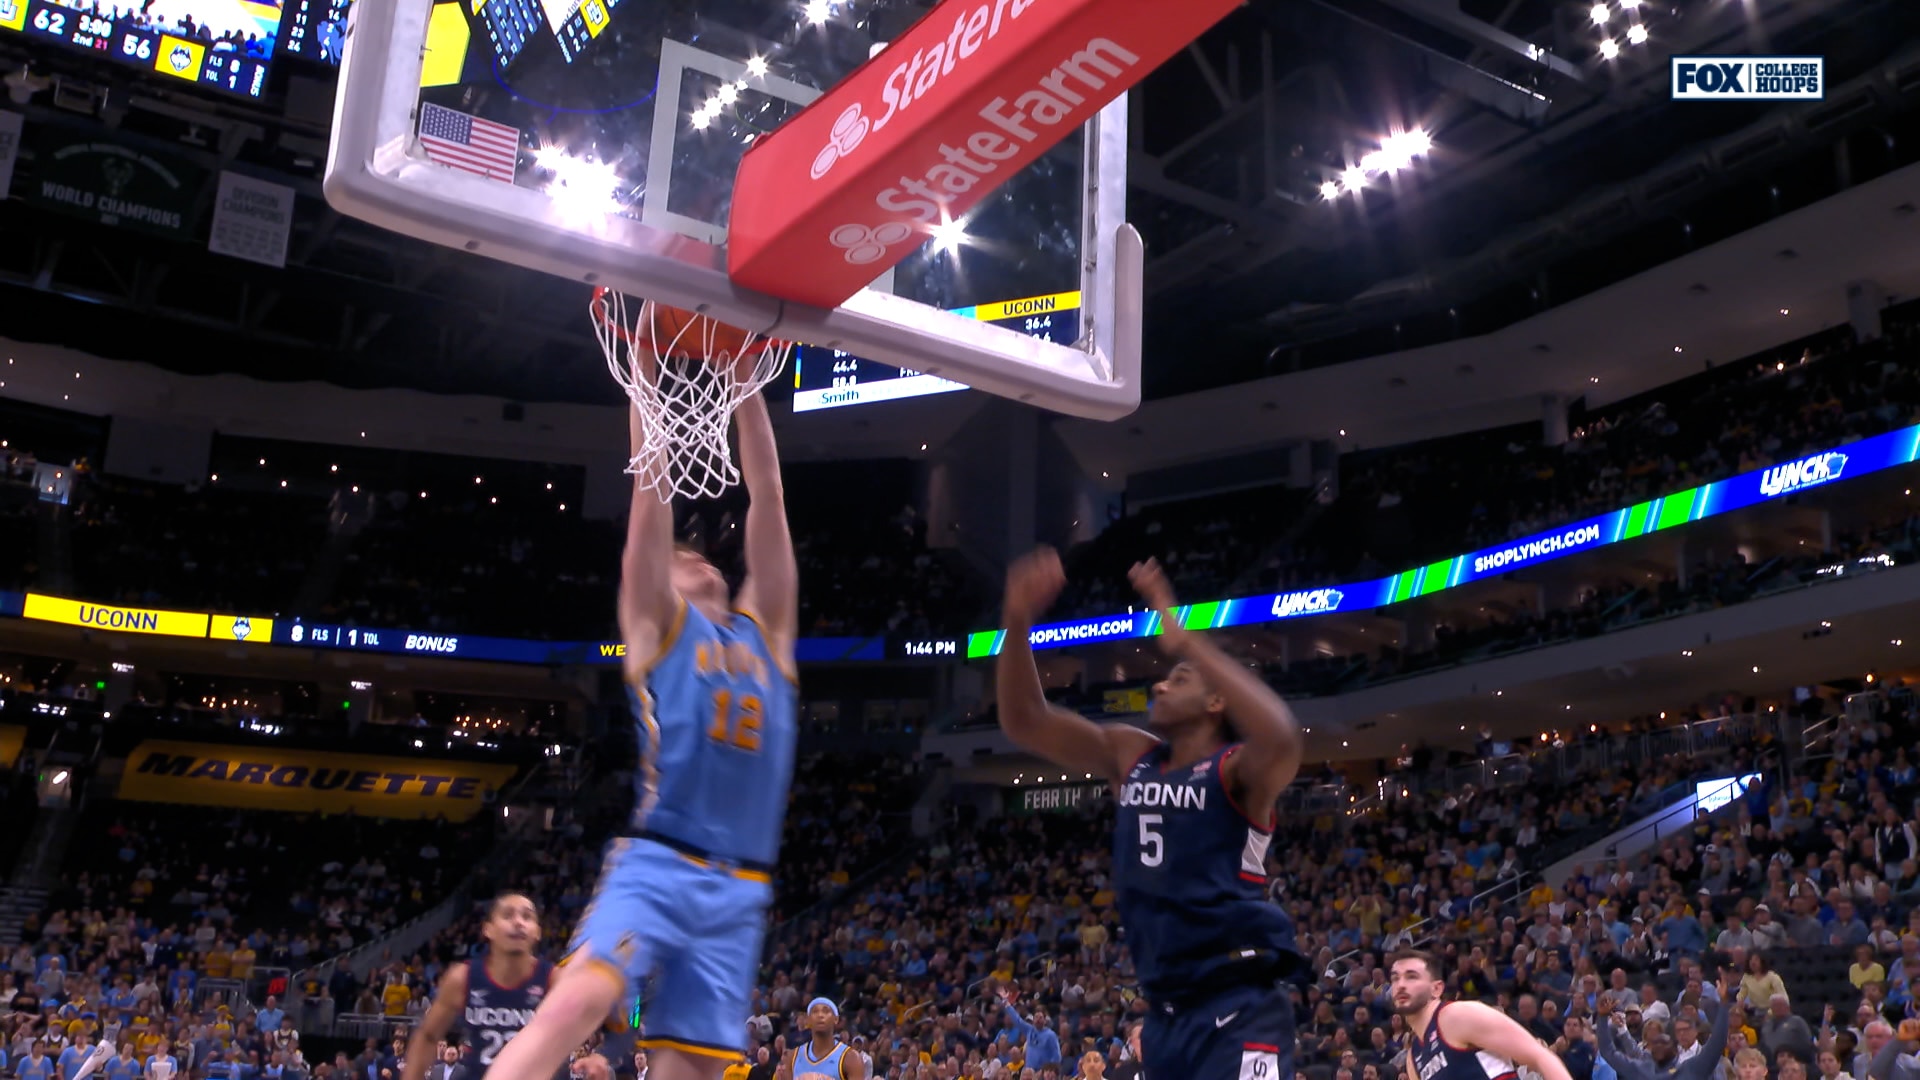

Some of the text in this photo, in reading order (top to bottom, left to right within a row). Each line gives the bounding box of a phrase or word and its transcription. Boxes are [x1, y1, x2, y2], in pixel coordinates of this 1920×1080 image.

[34, 9, 66, 35] 62
[79, 14, 112, 38] 3:00
[296, 12, 307, 25] 11
[72, 32, 108, 51] 2nd 21
[123, 33, 151, 59] 56
[209, 54, 223, 68] FLS
[206, 69, 237, 89] TOL 1
[250, 64, 265, 97] BONUS
[42, 180, 181, 228] WORLD CHAMPIONS
[1003, 296, 1055, 316] UCONN
[1025, 315, 1051, 330] 36.4
[832, 359, 857, 373] 44.4
[821, 390, 859, 404] Smith
[1760, 452, 1831, 496] LYNCH
[1474, 524, 1600, 573] SHOPLYNCH.COM
[1271, 588, 1332, 618] LYNCH
[79, 605, 158, 631] UCONN
[291, 624, 458, 653] 8 FLS 1 TOL BONUS
[1028, 619, 1133, 645] HOPLYNCH.COM
[905, 641, 956, 655] 1:44 PM
[708, 688, 763, 752] 12
[137, 752, 481, 799] MARQUETTE
[1024, 787, 1060, 810] FEAR
[1120, 782, 1206, 812] UCONN
[1138, 813, 1164, 868] 5
